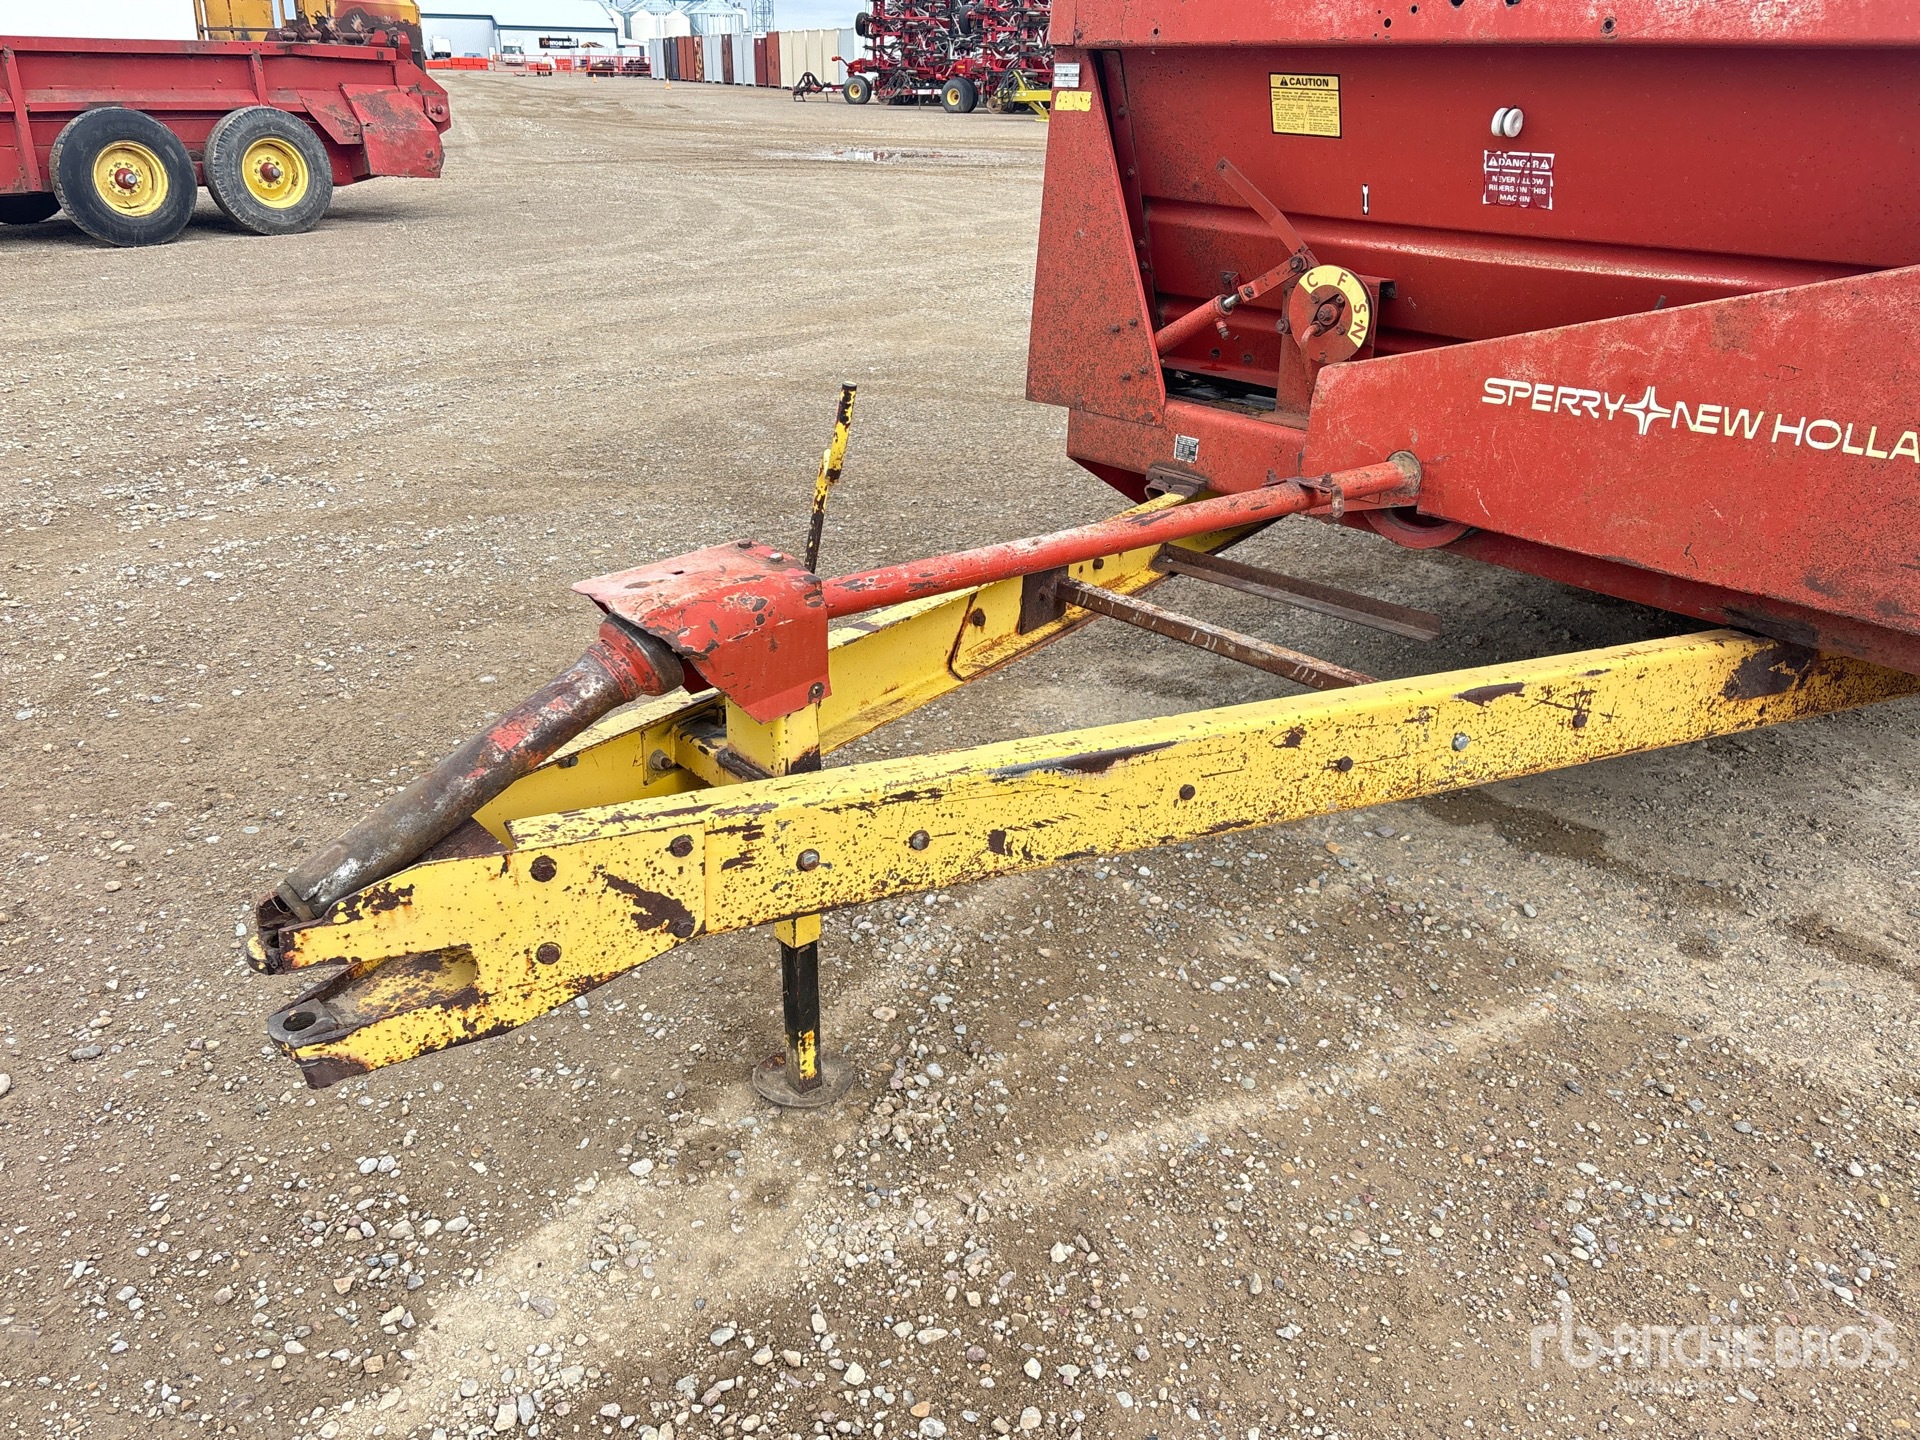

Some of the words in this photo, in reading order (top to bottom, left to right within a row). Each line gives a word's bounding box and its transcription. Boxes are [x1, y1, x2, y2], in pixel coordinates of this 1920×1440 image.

[1289, 77, 1329, 87] CAUTION
[1499, 194, 1531, 202] MACHIN
[1306, 272, 1318, 288] C
[1337, 271, 1348, 286] F
[1353, 303, 1367, 314] S
[1481, 377, 1626, 421] SPERRY
[1670, 400, 1765, 440] NEW
